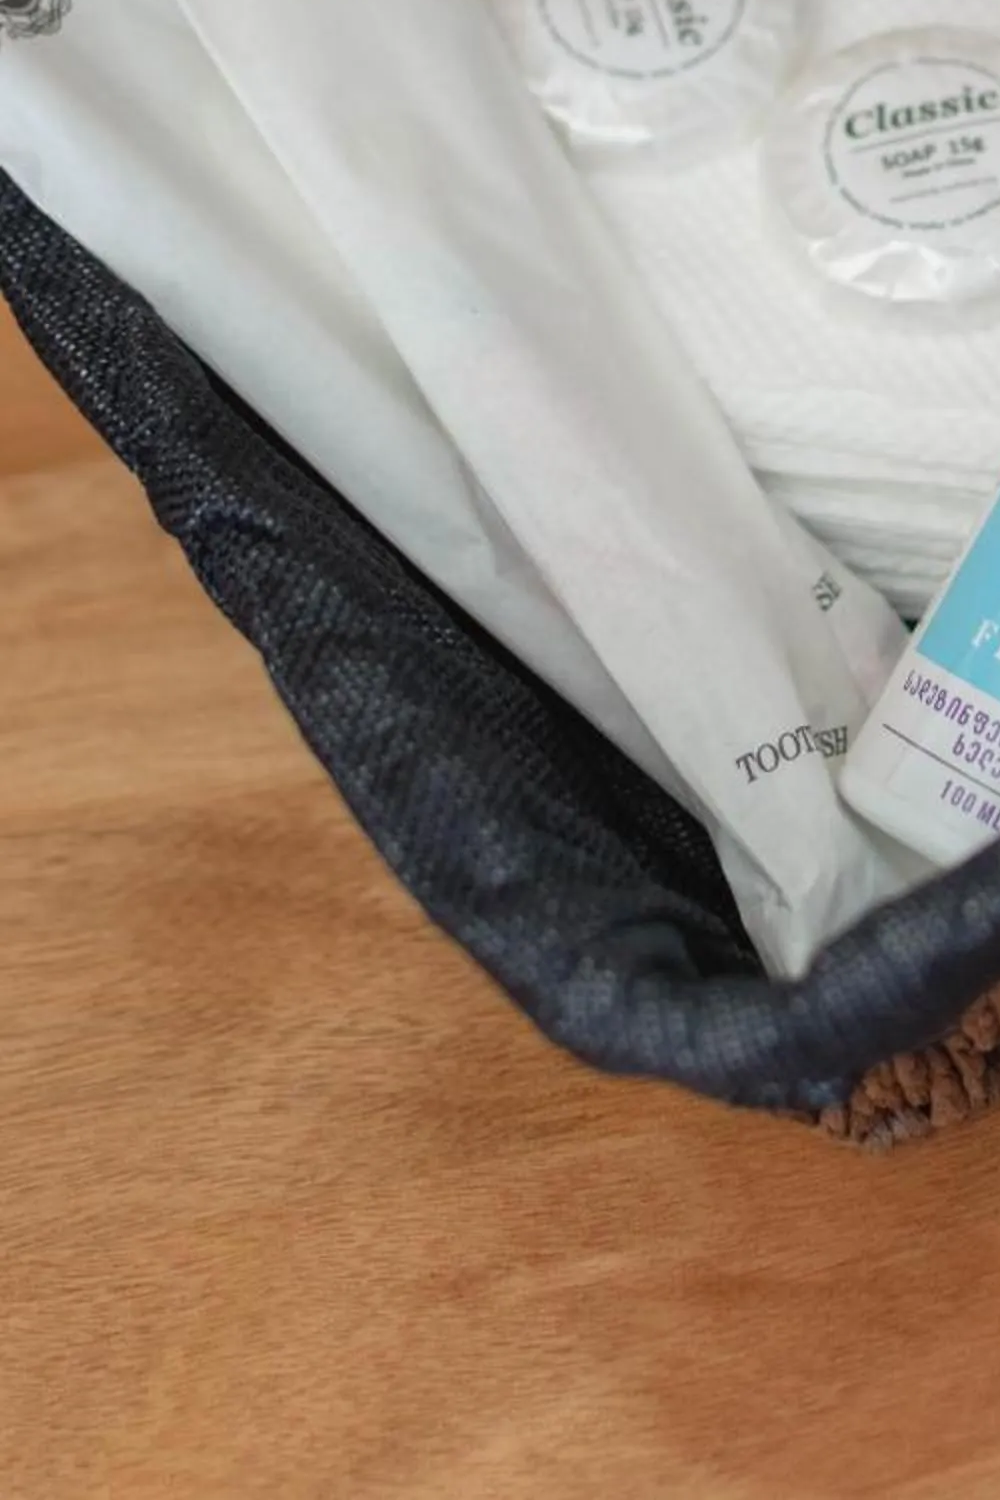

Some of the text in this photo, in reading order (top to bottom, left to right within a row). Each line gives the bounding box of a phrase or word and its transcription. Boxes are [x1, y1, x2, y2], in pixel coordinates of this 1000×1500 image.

[844, 85, 999, 140] Classic
[880, 143, 938, 171] SOAP
[948, 136, 986, 155] 15g
[940, 779, 978, 814] 100
